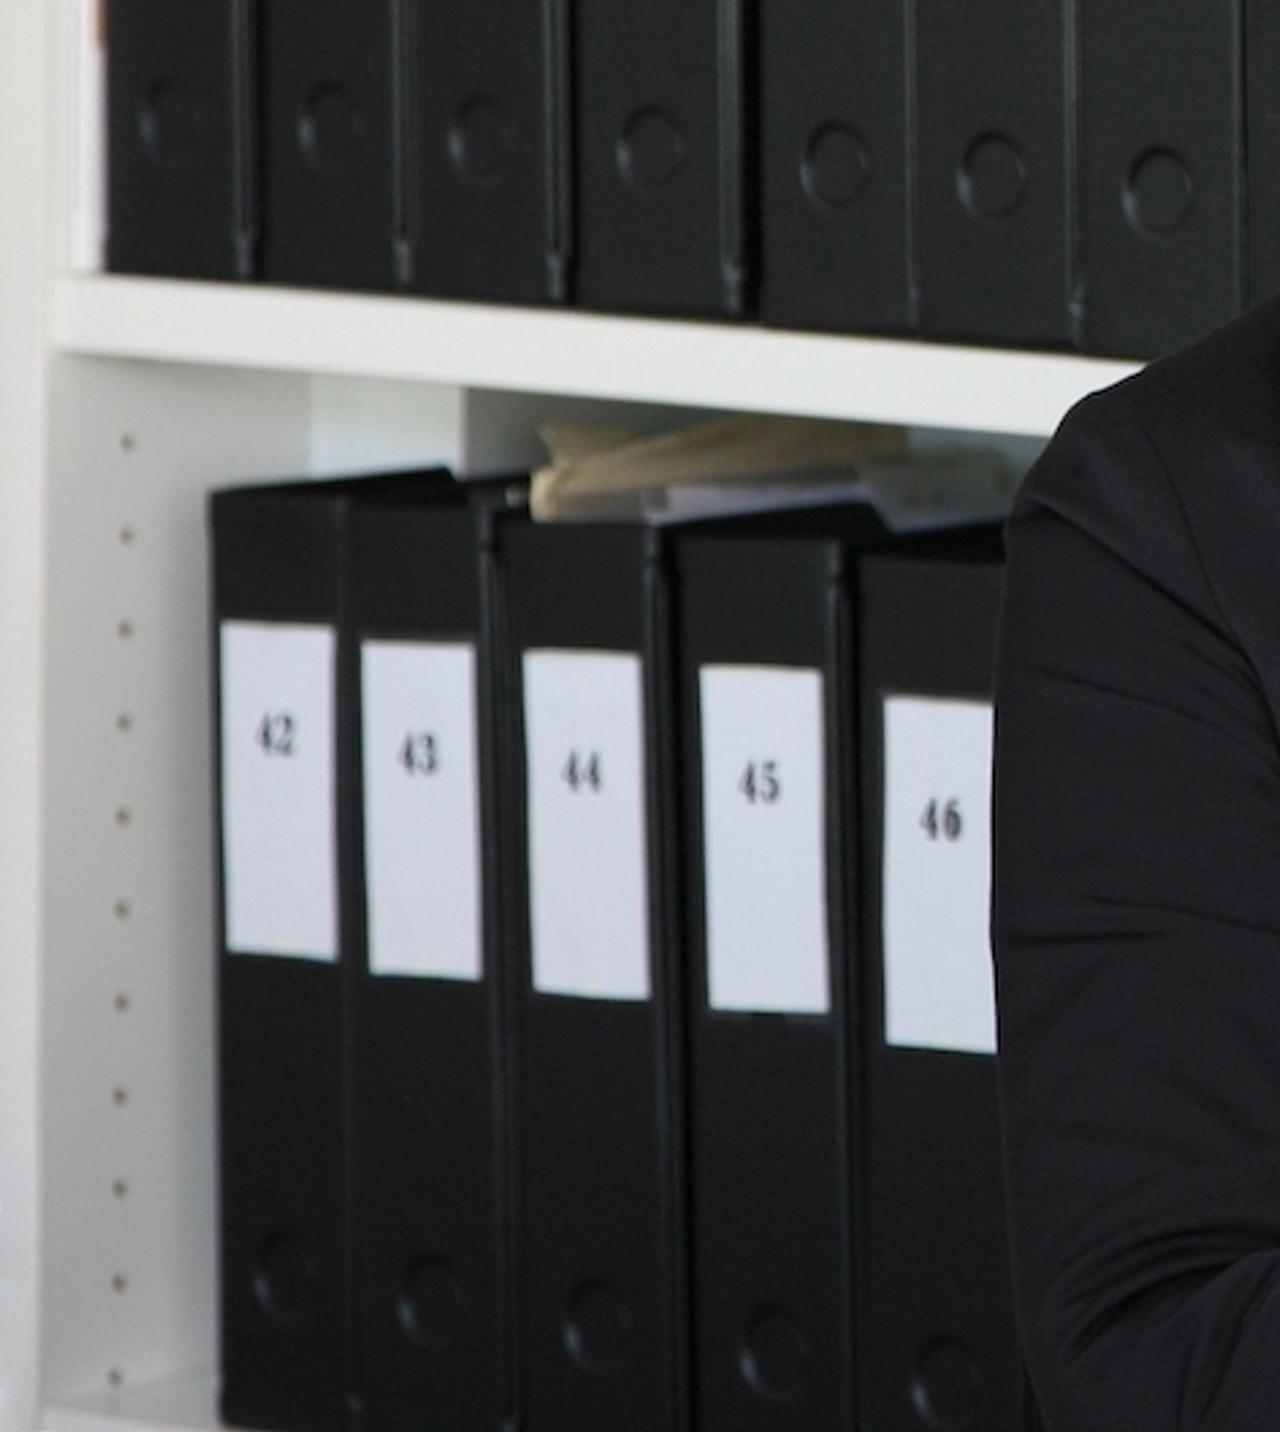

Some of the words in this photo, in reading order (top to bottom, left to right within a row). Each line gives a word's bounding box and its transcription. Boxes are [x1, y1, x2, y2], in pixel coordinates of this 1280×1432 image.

[257, 713, 296, 757] 42
[399, 732, 439, 776] 43
[561, 750, 603, 794] 44
[738, 759, 781, 805] 45
[919, 797, 964, 842] 46
